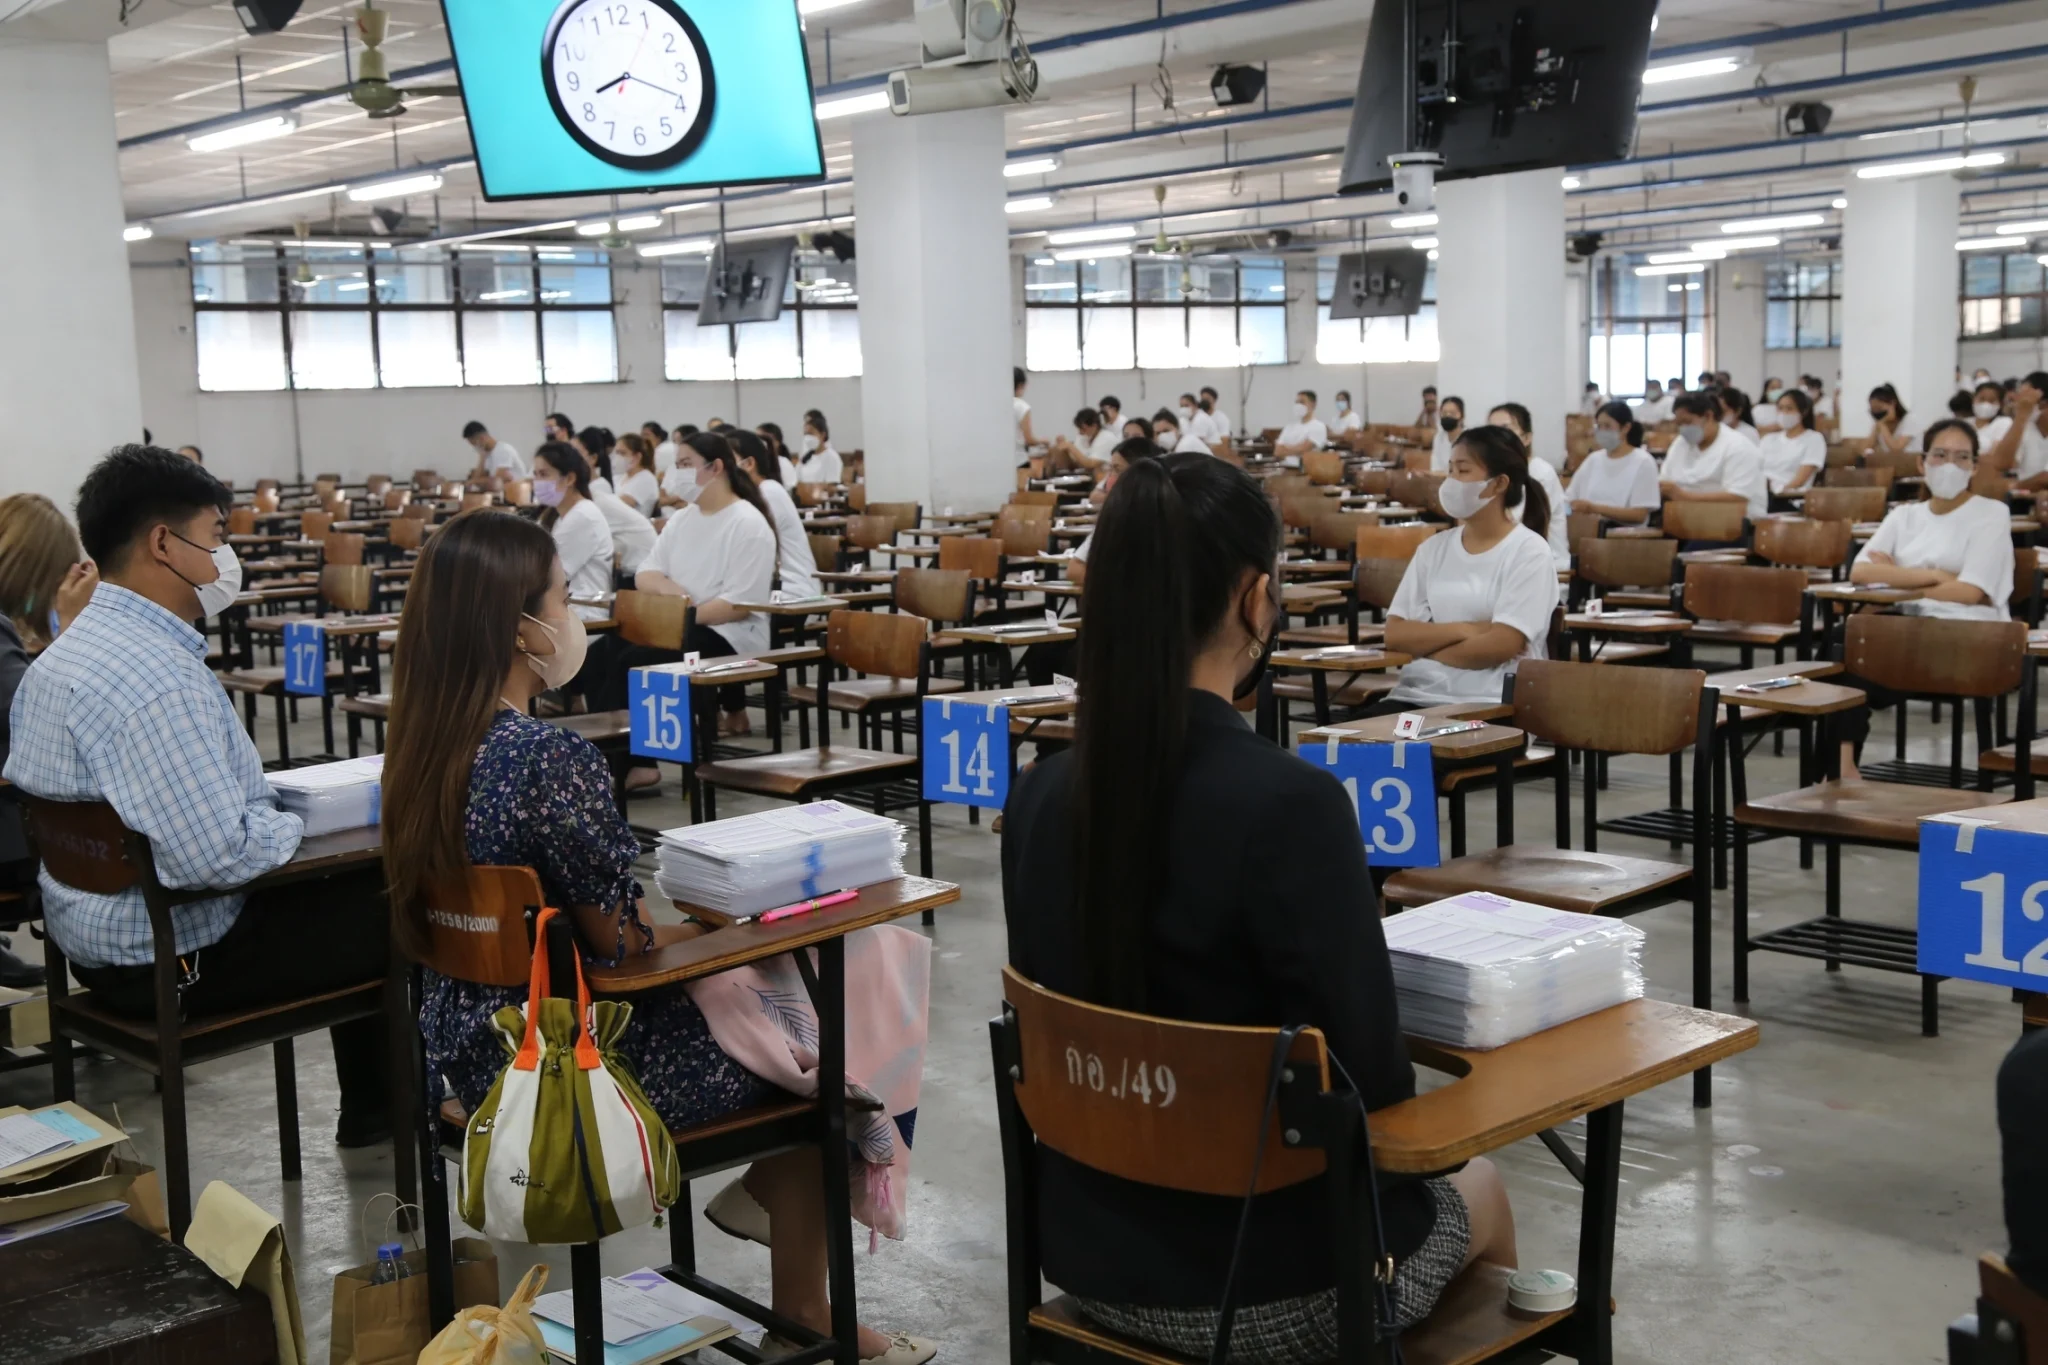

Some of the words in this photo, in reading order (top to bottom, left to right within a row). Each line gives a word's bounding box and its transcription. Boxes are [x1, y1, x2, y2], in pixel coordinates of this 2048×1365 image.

[604, 4, 631, 26] 12
[639, 10, 649, 31] 1
[577, 16, 601, 36] 11
[560, 42, 586, 62] 10
[662, 32, 677, 53] 2
[566, 71, 580, 92] 9
[674, 62, 688, 83] 3
[582, 102, 597, 123] 8
[674, 94, 688, 114] 4
[603, 121, 616, 141] 7
[633, 126, 647, 146] 6
[659, 116, 673, 137] 5
[292, 642, 318, 688] 17
[641, 694, 682, 751] 15
[940, 729, 995, 797] 14
